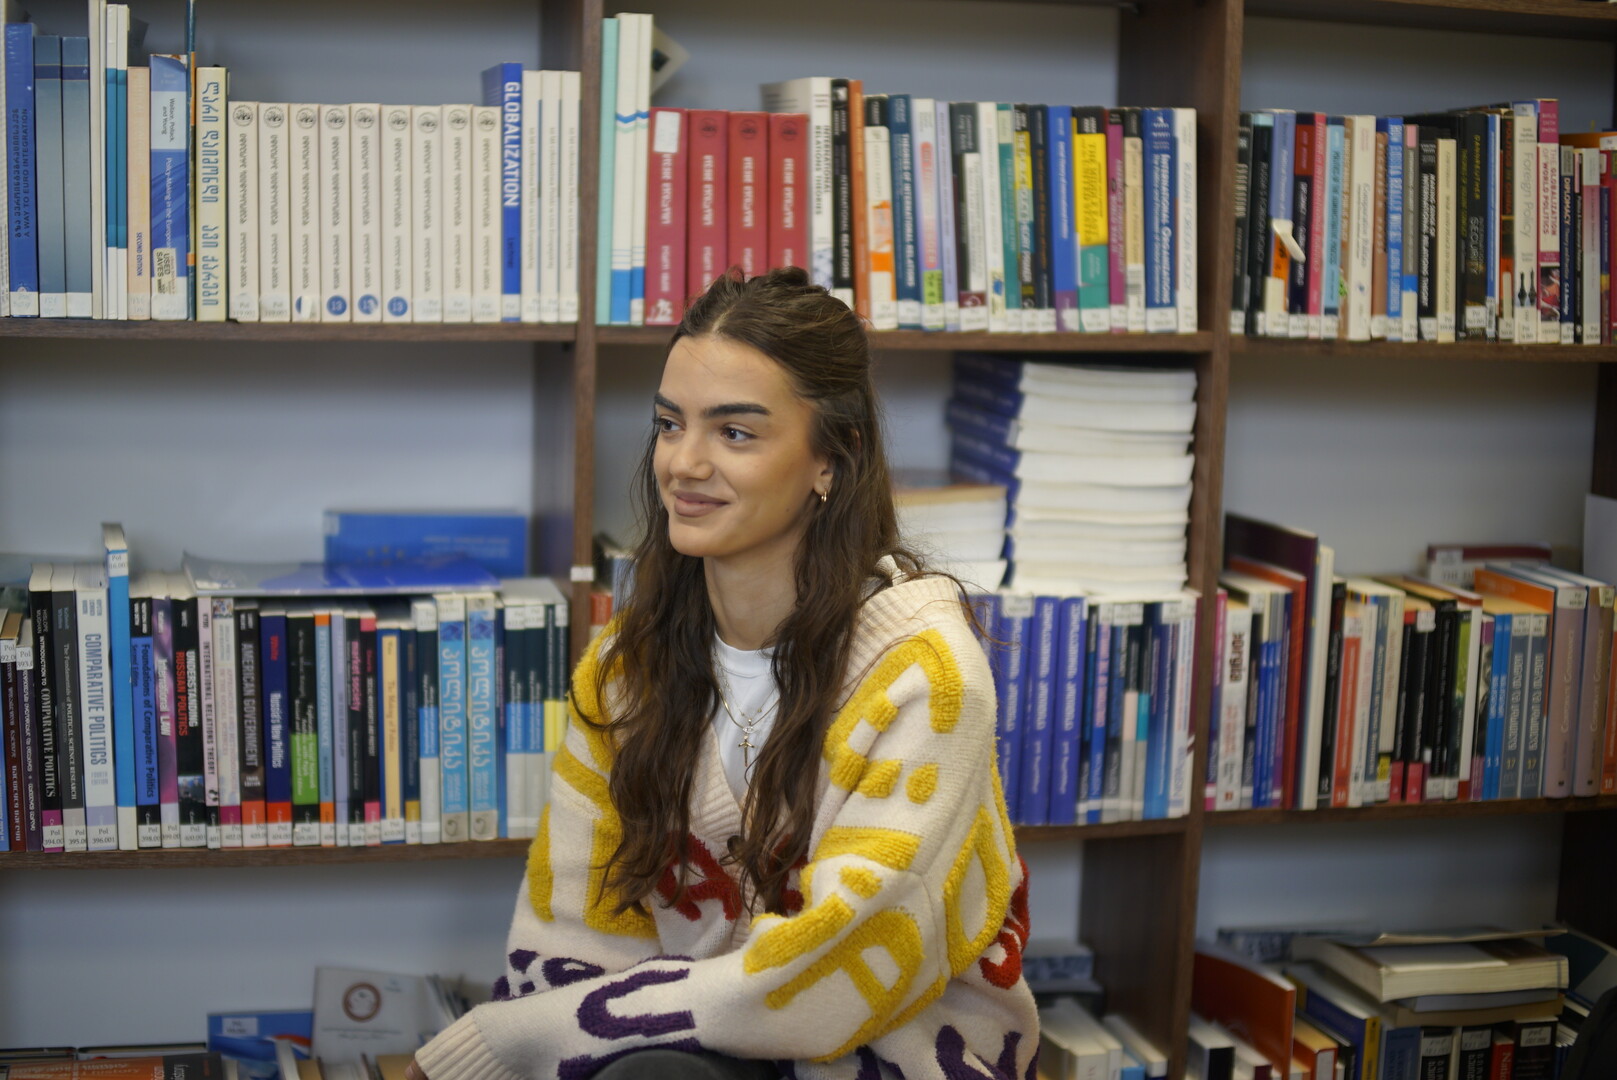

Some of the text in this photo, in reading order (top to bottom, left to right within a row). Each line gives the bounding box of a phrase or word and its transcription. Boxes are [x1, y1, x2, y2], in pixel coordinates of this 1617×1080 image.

[21, 108, 29, 167] INTEGRATION
[201, 81, 220, 203] ლარი დაიმონდი
[503, 81, 521, 207] GLOBALIZATION
[815, 125, 824, 215] RELATIONS THEORIES
[823, 125, 832, 193] INTERNATIONAL
[1504, 121, 1513, 168] POLITICS
[23, 197, 30, 208] TO
[164, 157, 172, 200] Policy-Making
[902, 133, 915, 287] THEORIES OF INTERNATIONAL RELATIONS
[1017, 134, 1032, 282] THE PUBLIC POLICY THEORY PRIMER
[1505, 181, 1513, 213] CHINA
[1519, 151, 1535, 239] Foreign Policy
[156, 251, 164, 277] SAVES
[163, 253, 171, 275] USED
[201, 225, 220, 248] ავი
[840, 174, 850, 278] INTERNATIONAL RELATIONS
[1160, 153, 1172, 304] INTERNATIONAL ORGANIZATIONS
[1182, 162, 1193, 290] RUSSIAN FOREIGN POLICY
[1469, 217, 1479, 275] SECURITY
[63, 643, 71, 655] The
[64, 655, 72, 698] Fundamentals
[351, 640, 361, 711] market society
[39, 636, 56, 798] INTRODUCTION TO COMPARATIVE POLITICS
[66, 703, 74, 737] POLITICAL
[85, 633, 107, 766] COMPARATIVE POLITICS
[141, 643, 155, 798] Foundations of Comparative Politics
[158, 658, 171, 736] International LAW
[176, 651, 188, 736] RUSSIAN POLITICS
[186, 650, 198, 728] UNDERSTANDING
[203, 641, 216, 776] INTERNATIONAL RELATIONS THEORY
[241, 643, 259, 767] AMERICAN GOVERNMENT
[319, 630, 330, 748] RETHINKING GOVERNANCE
[443, 648, 462, 770] პოლიტიკა
[471, 646, 491, 768] პოლიტიკა
[1560, 683, 1572, 734] CORPORATE
[1589, 681, 1600, 732] CORPORATE
[68, 738, 76, 766] SCIENCE
[269, 692, 284, 769] Russia's New Politics
[69, 766, 78, 800] RESEARCH
